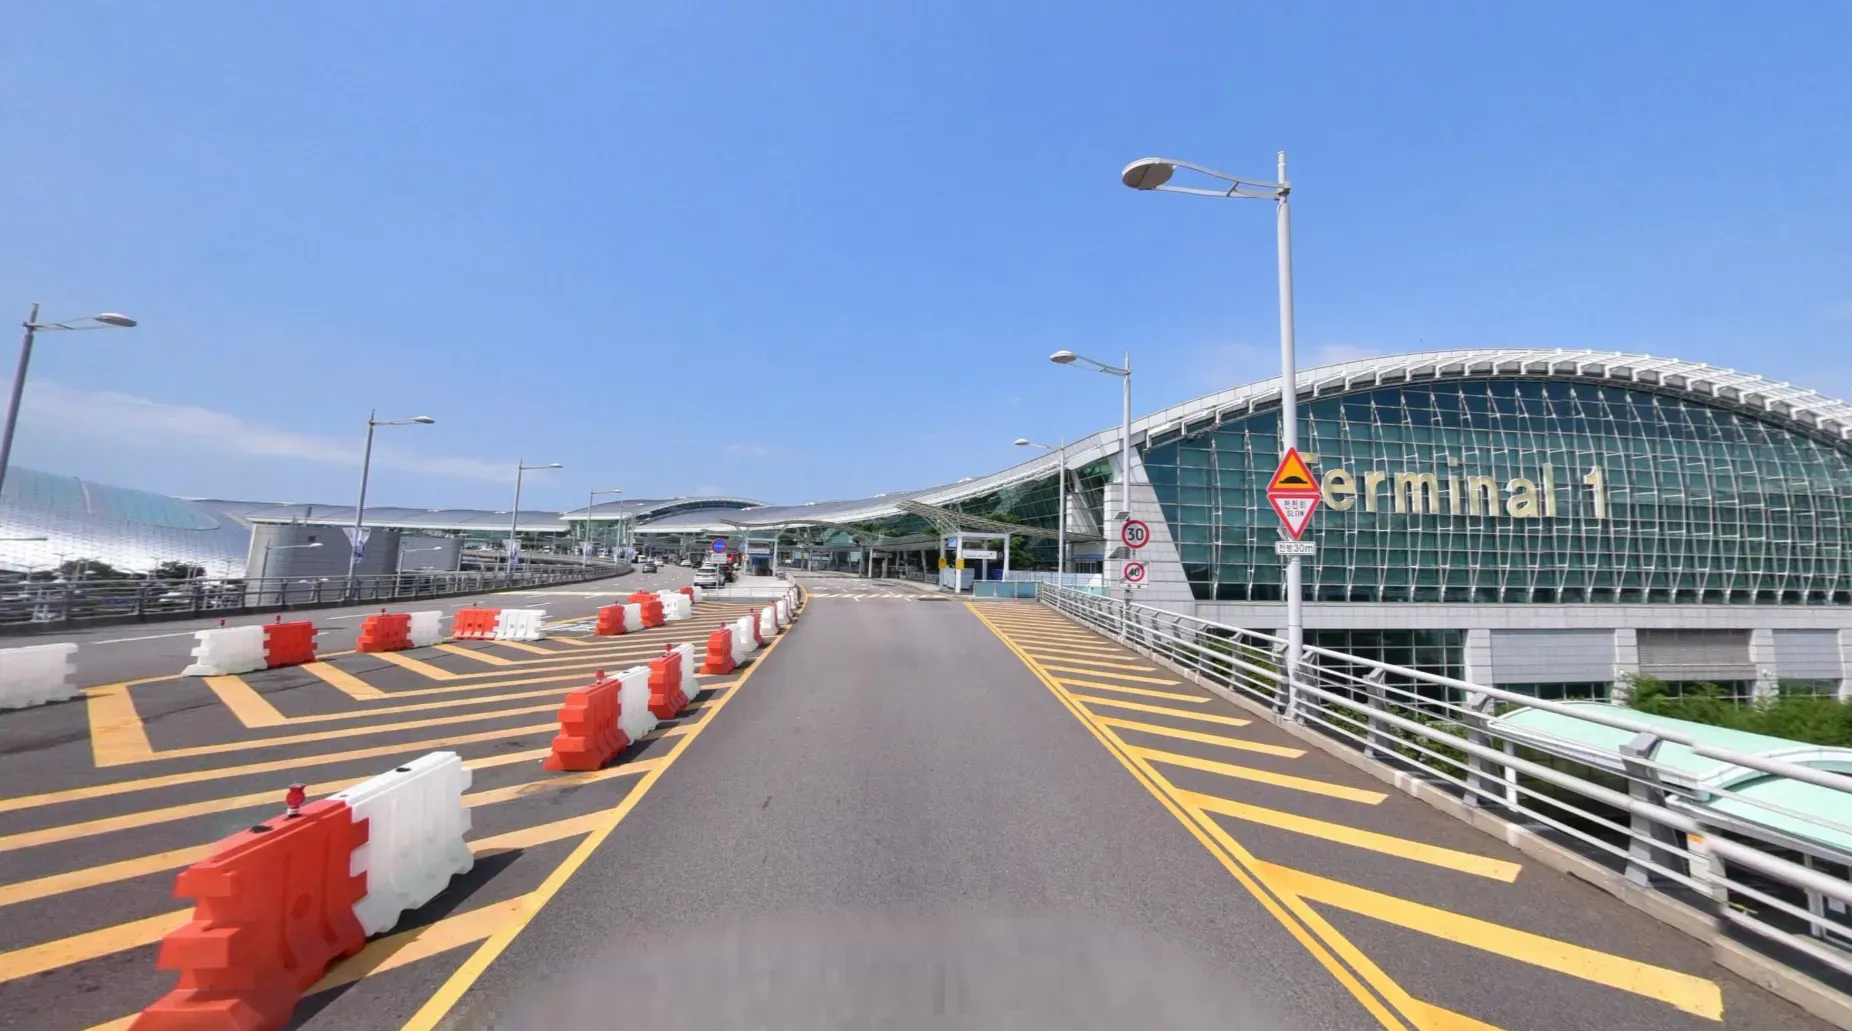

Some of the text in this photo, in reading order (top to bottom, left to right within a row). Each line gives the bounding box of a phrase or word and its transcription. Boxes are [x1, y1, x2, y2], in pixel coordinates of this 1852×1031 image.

[1583, 466, 1605, 519] 1
[1127, 528, 1144, 541] 30
[1128, 567, 1140, 577] 40
